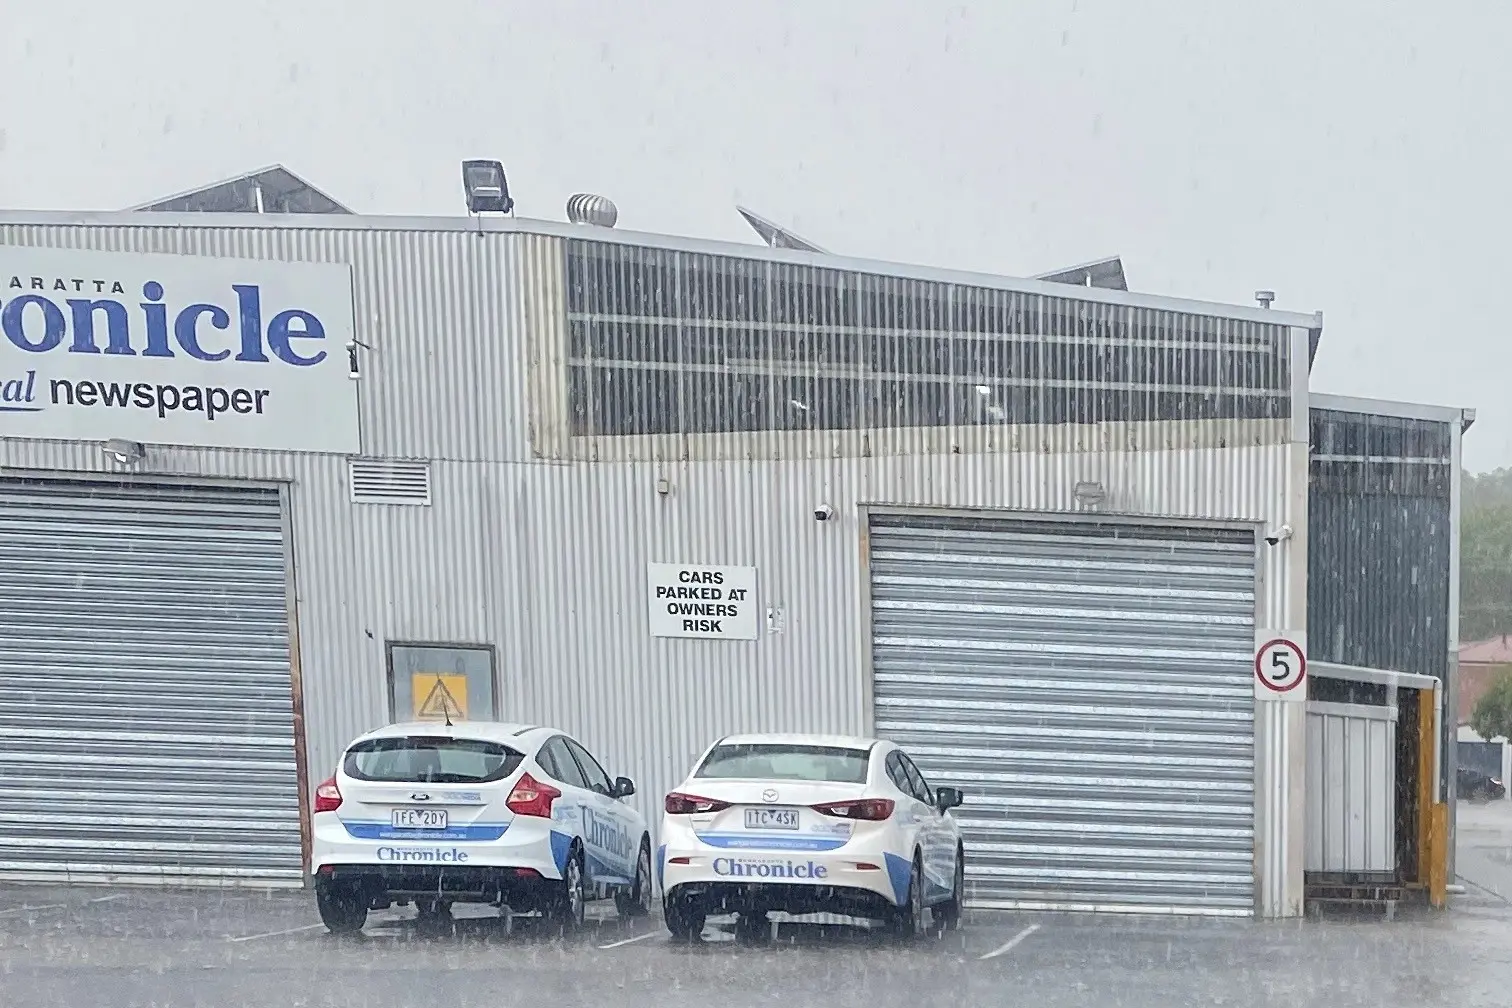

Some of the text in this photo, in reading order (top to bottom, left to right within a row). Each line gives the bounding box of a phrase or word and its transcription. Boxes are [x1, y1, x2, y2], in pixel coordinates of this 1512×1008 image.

[0, 281, 328, 367] onicle
[0, 370, 270, 421] al newspaper
[678, 570, 724, 585] CARS
[656, 586, 748, 601] PARKED AT
[667, 602, 738, 617] OWNERS
[683, 619, 722, 632] RISK
[1272, 651, 1290, 680] 5
[376, 846, 469, 863] Chronicle
[712, 857, 829, 879] Chronicle
